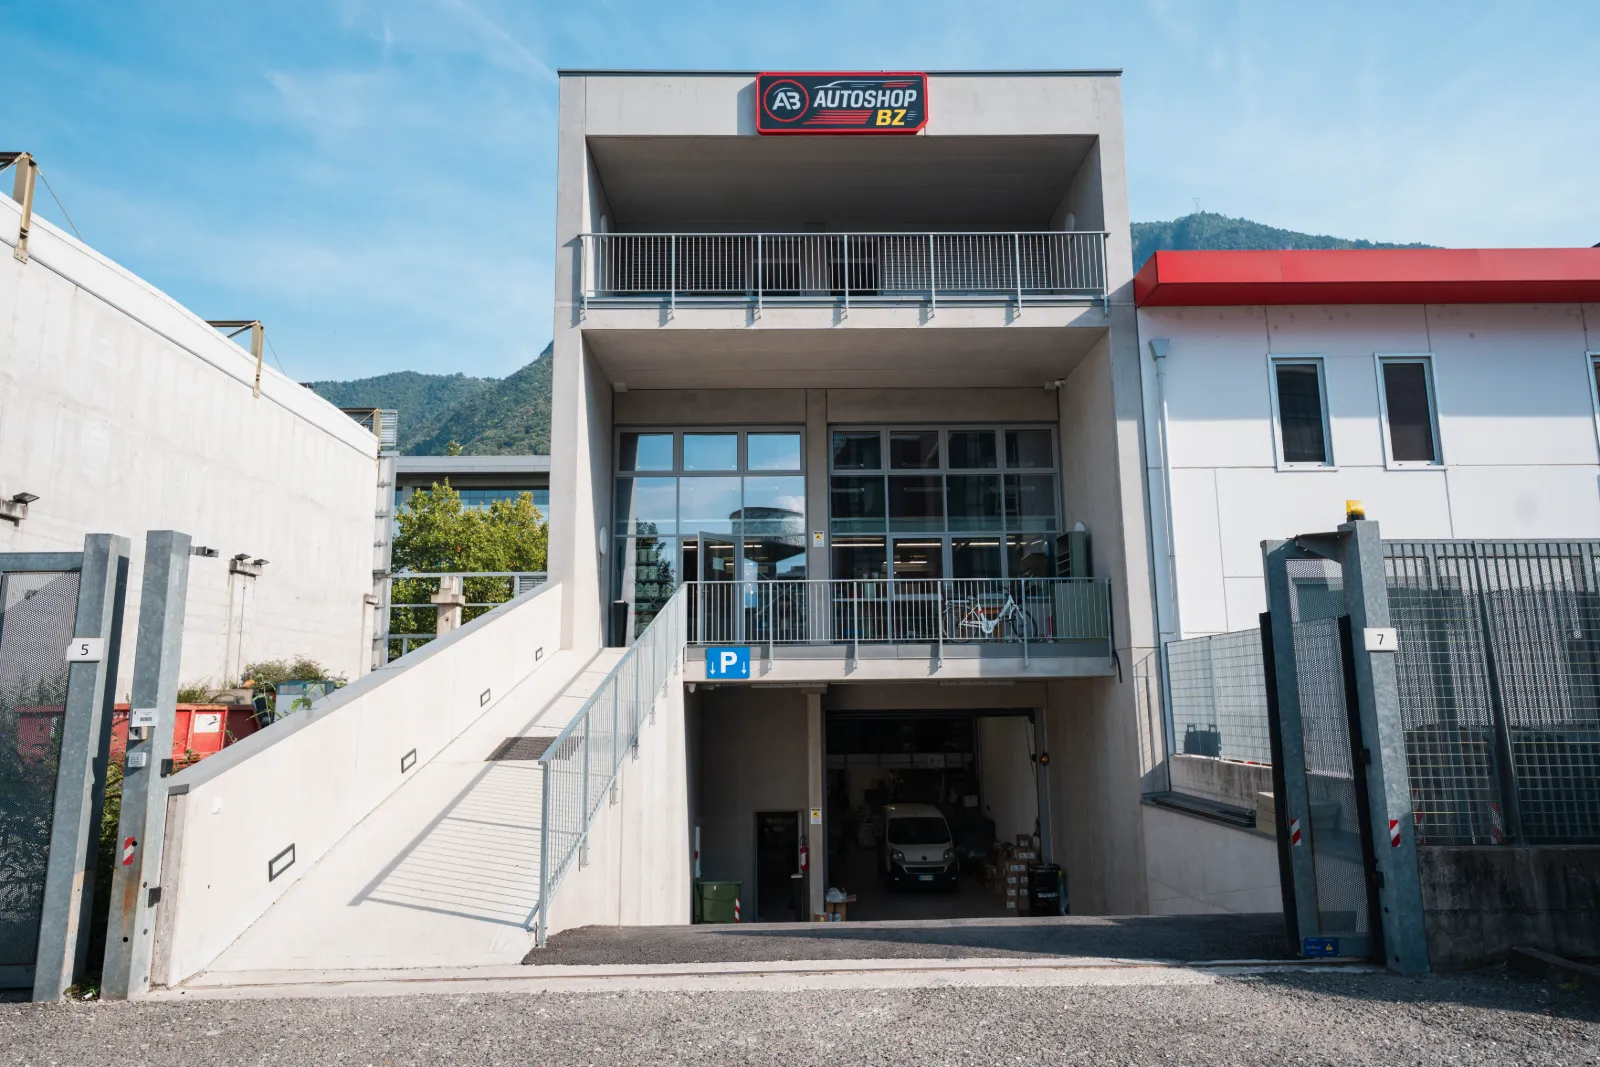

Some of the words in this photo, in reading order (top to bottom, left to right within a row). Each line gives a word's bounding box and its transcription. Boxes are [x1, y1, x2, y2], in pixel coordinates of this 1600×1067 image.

[772, 91, 801, 111] AB
[813, 89, 917, 108] AUTOSHOP
[876, 109, 907, 126] BZ
[1376, 633, 1384, 645] 7
[80, 643, 89, 656] 5
[720, 651, 738, 674] P
